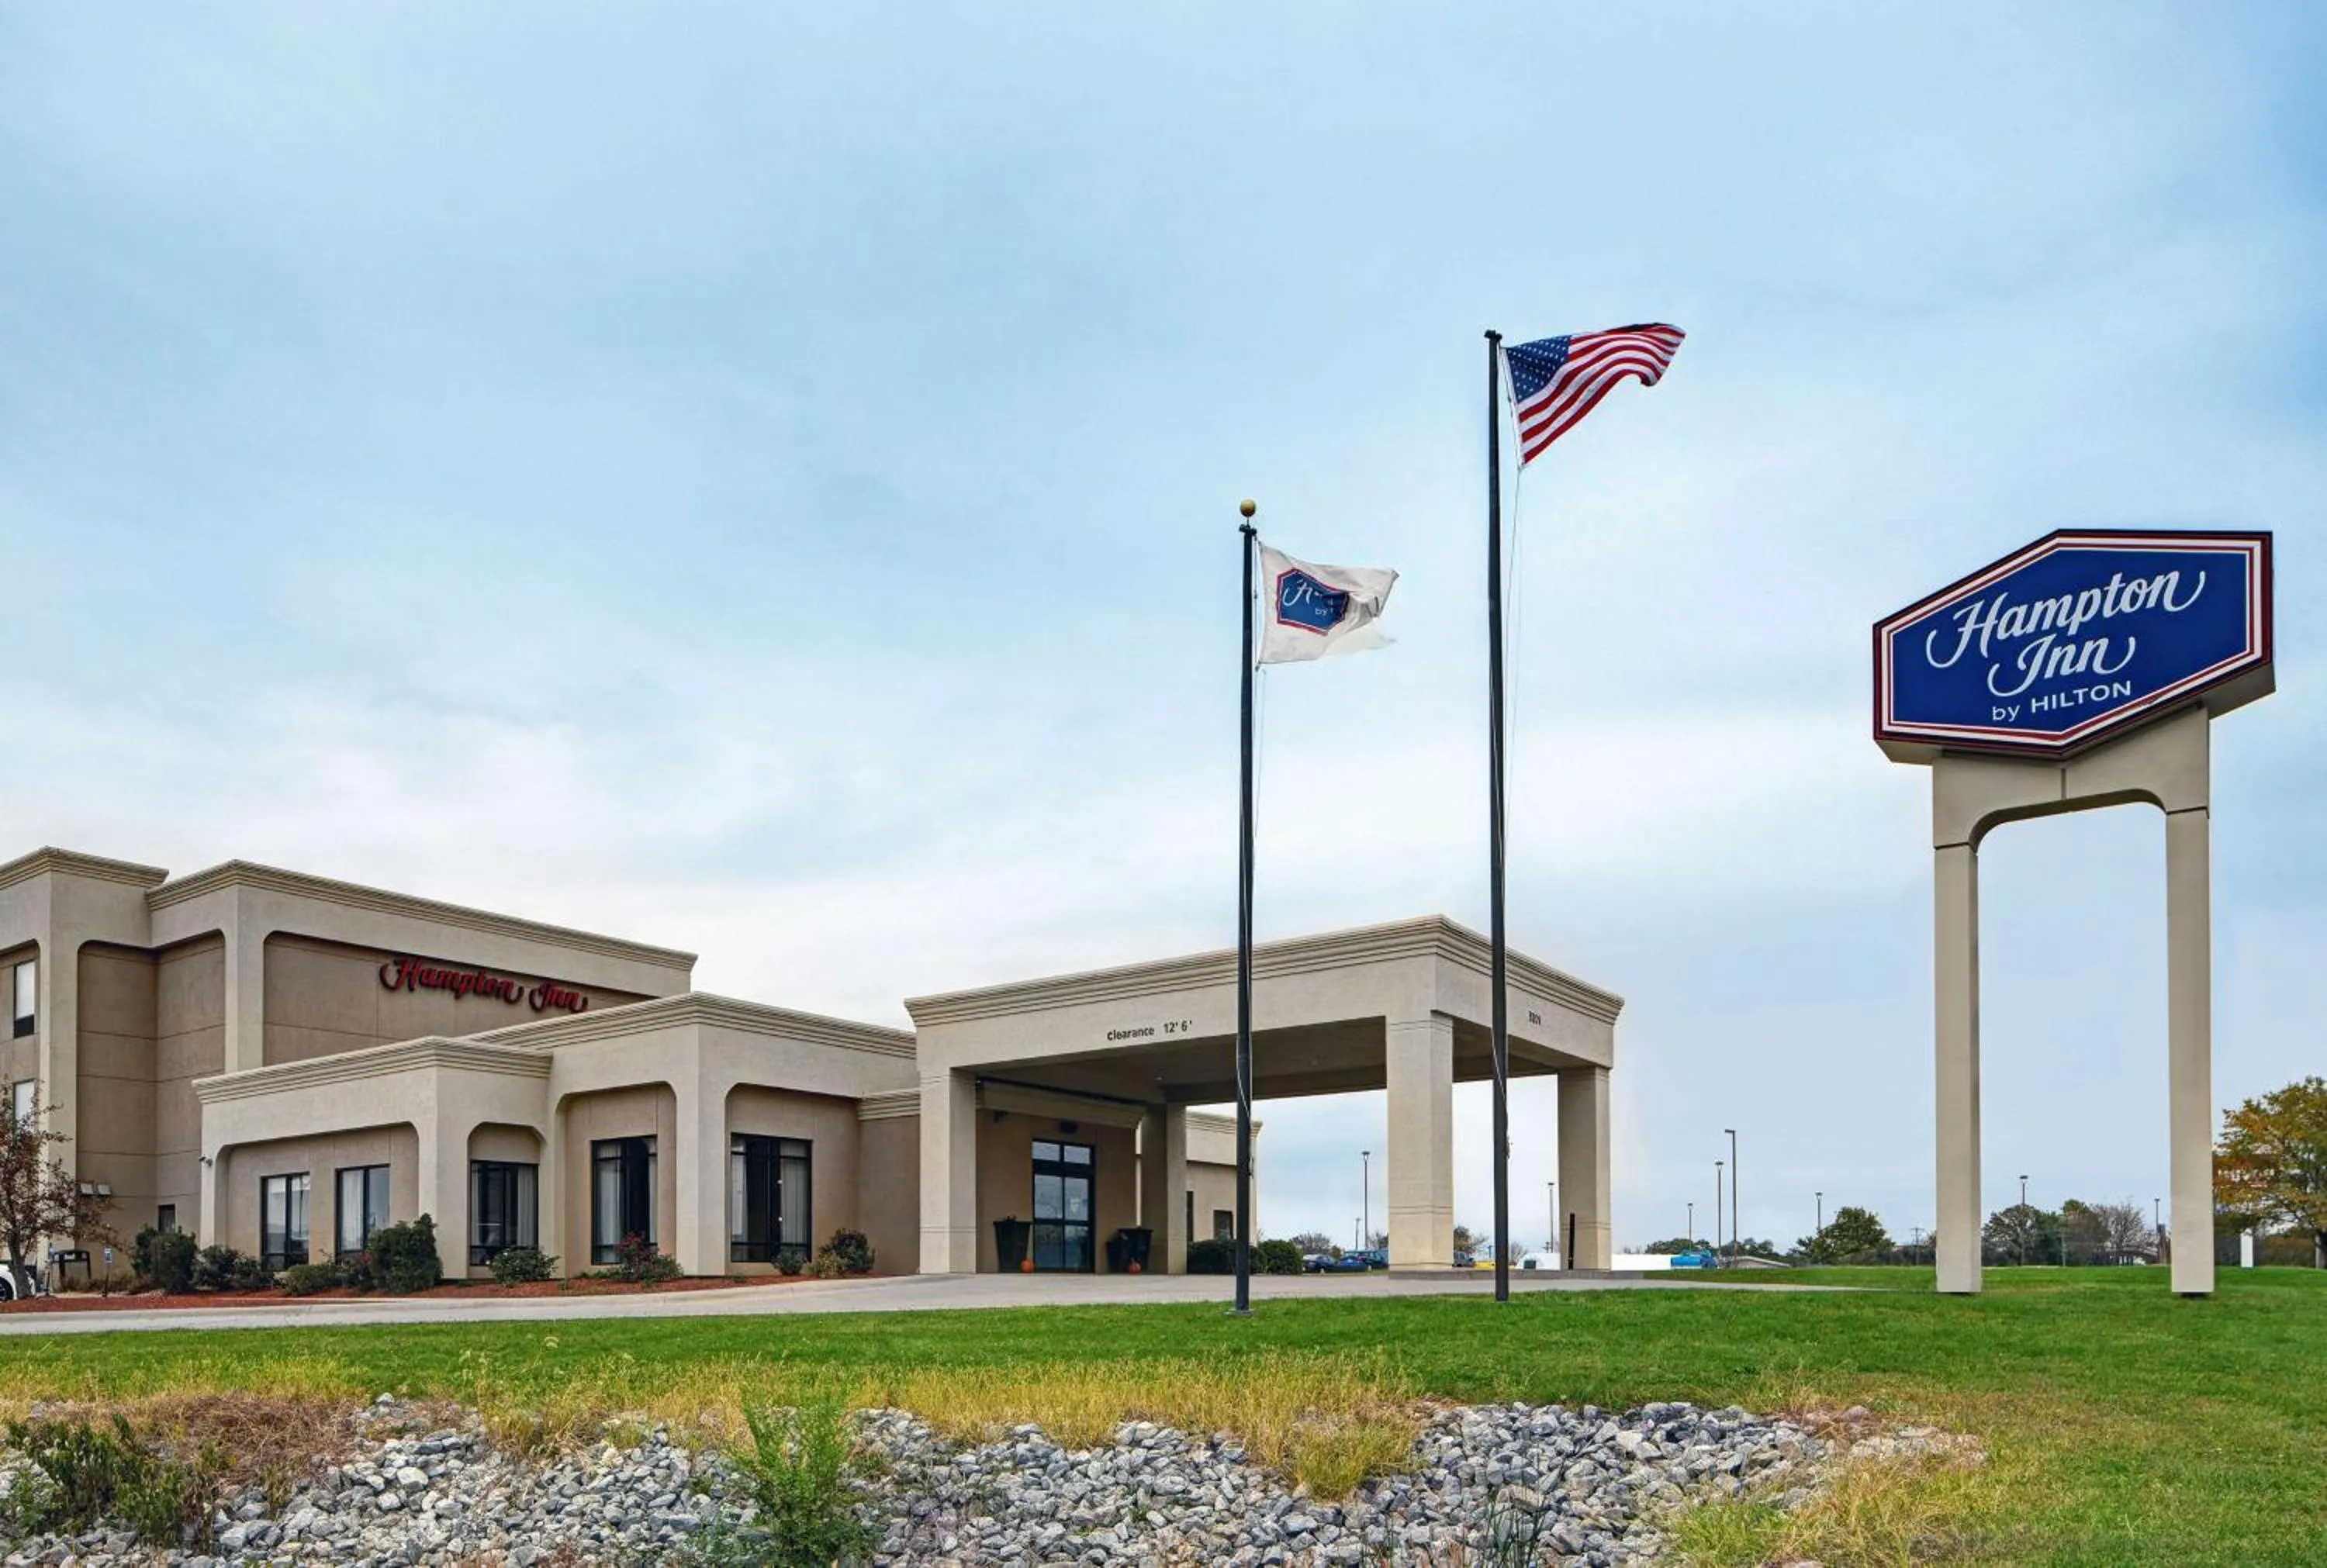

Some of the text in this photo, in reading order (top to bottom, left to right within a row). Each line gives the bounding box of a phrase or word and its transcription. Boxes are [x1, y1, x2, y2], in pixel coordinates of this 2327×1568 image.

[1926, 570, 2206, 667] Hampton
[1987, 633, 2136, 696] Inn
[1992, 680, 2132, 722] by HILTON
[379, 955, 588, 1013] Hampton Inn
[1107, 1027, 1154, 1041] clearance
